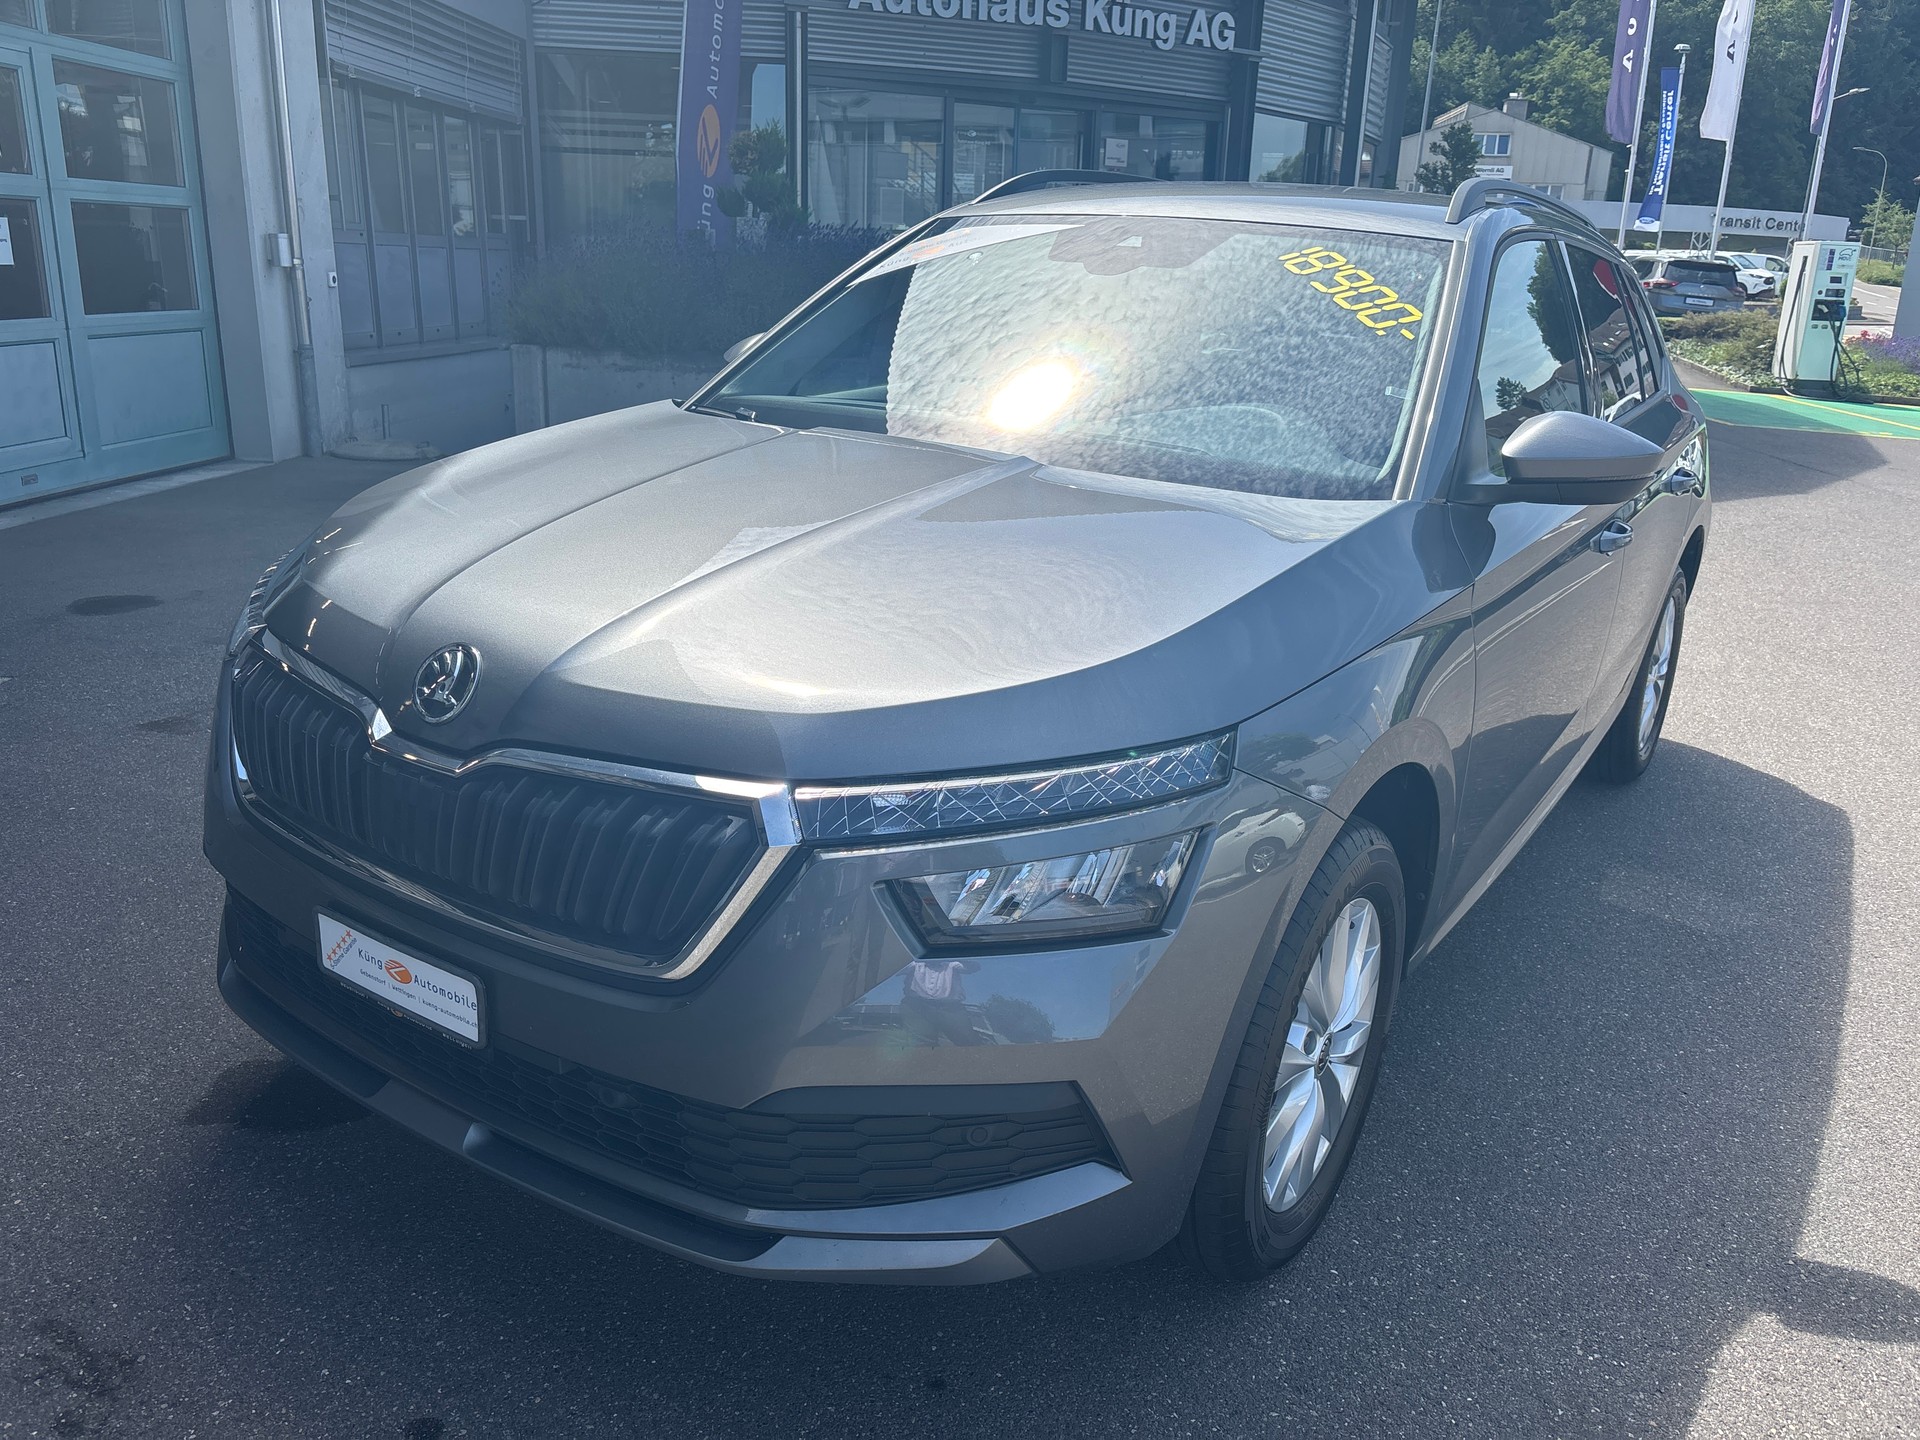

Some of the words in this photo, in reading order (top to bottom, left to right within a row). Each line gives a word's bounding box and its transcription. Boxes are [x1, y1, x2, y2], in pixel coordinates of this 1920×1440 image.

[1085, 0, 1177, 50] Küng
[1185, 8, 1236, 50] AG
[697, 184, 715, 231] üng
[1720, 216, 1761, 229] ransit
[357, 947, 383, 970] Küng
[413, 974, 477, 1011] Automobile
[360, 968, 386, 986] Gebenstorf
[392, 983, 416, 1000] Wettingen
